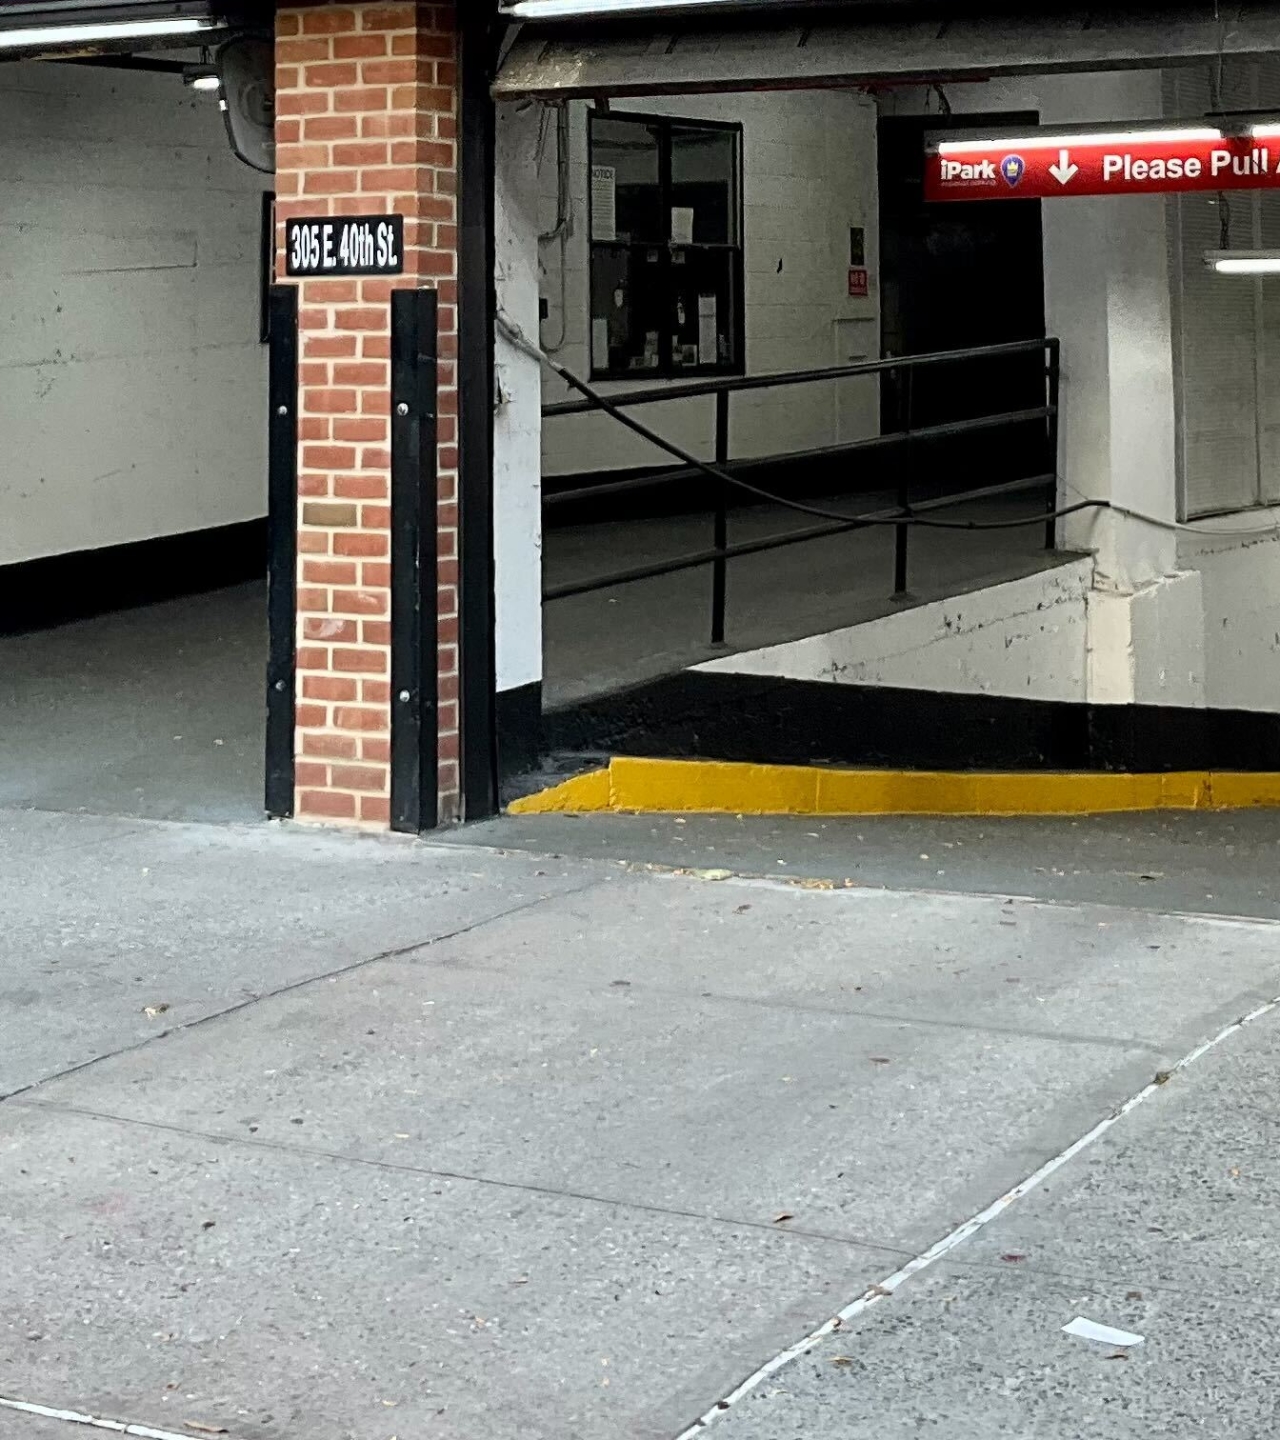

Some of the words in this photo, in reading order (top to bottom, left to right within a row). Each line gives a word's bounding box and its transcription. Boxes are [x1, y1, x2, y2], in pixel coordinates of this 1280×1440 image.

[940, 159, 996, 180] iPark
[1103, 154, 1202, 181] Please
[1211, 149, 1268, 176] Pull
[292, 224, 320, 268] 305
[340, 223, 374, 267] 40th
[376, 221, 398, 267] St.
